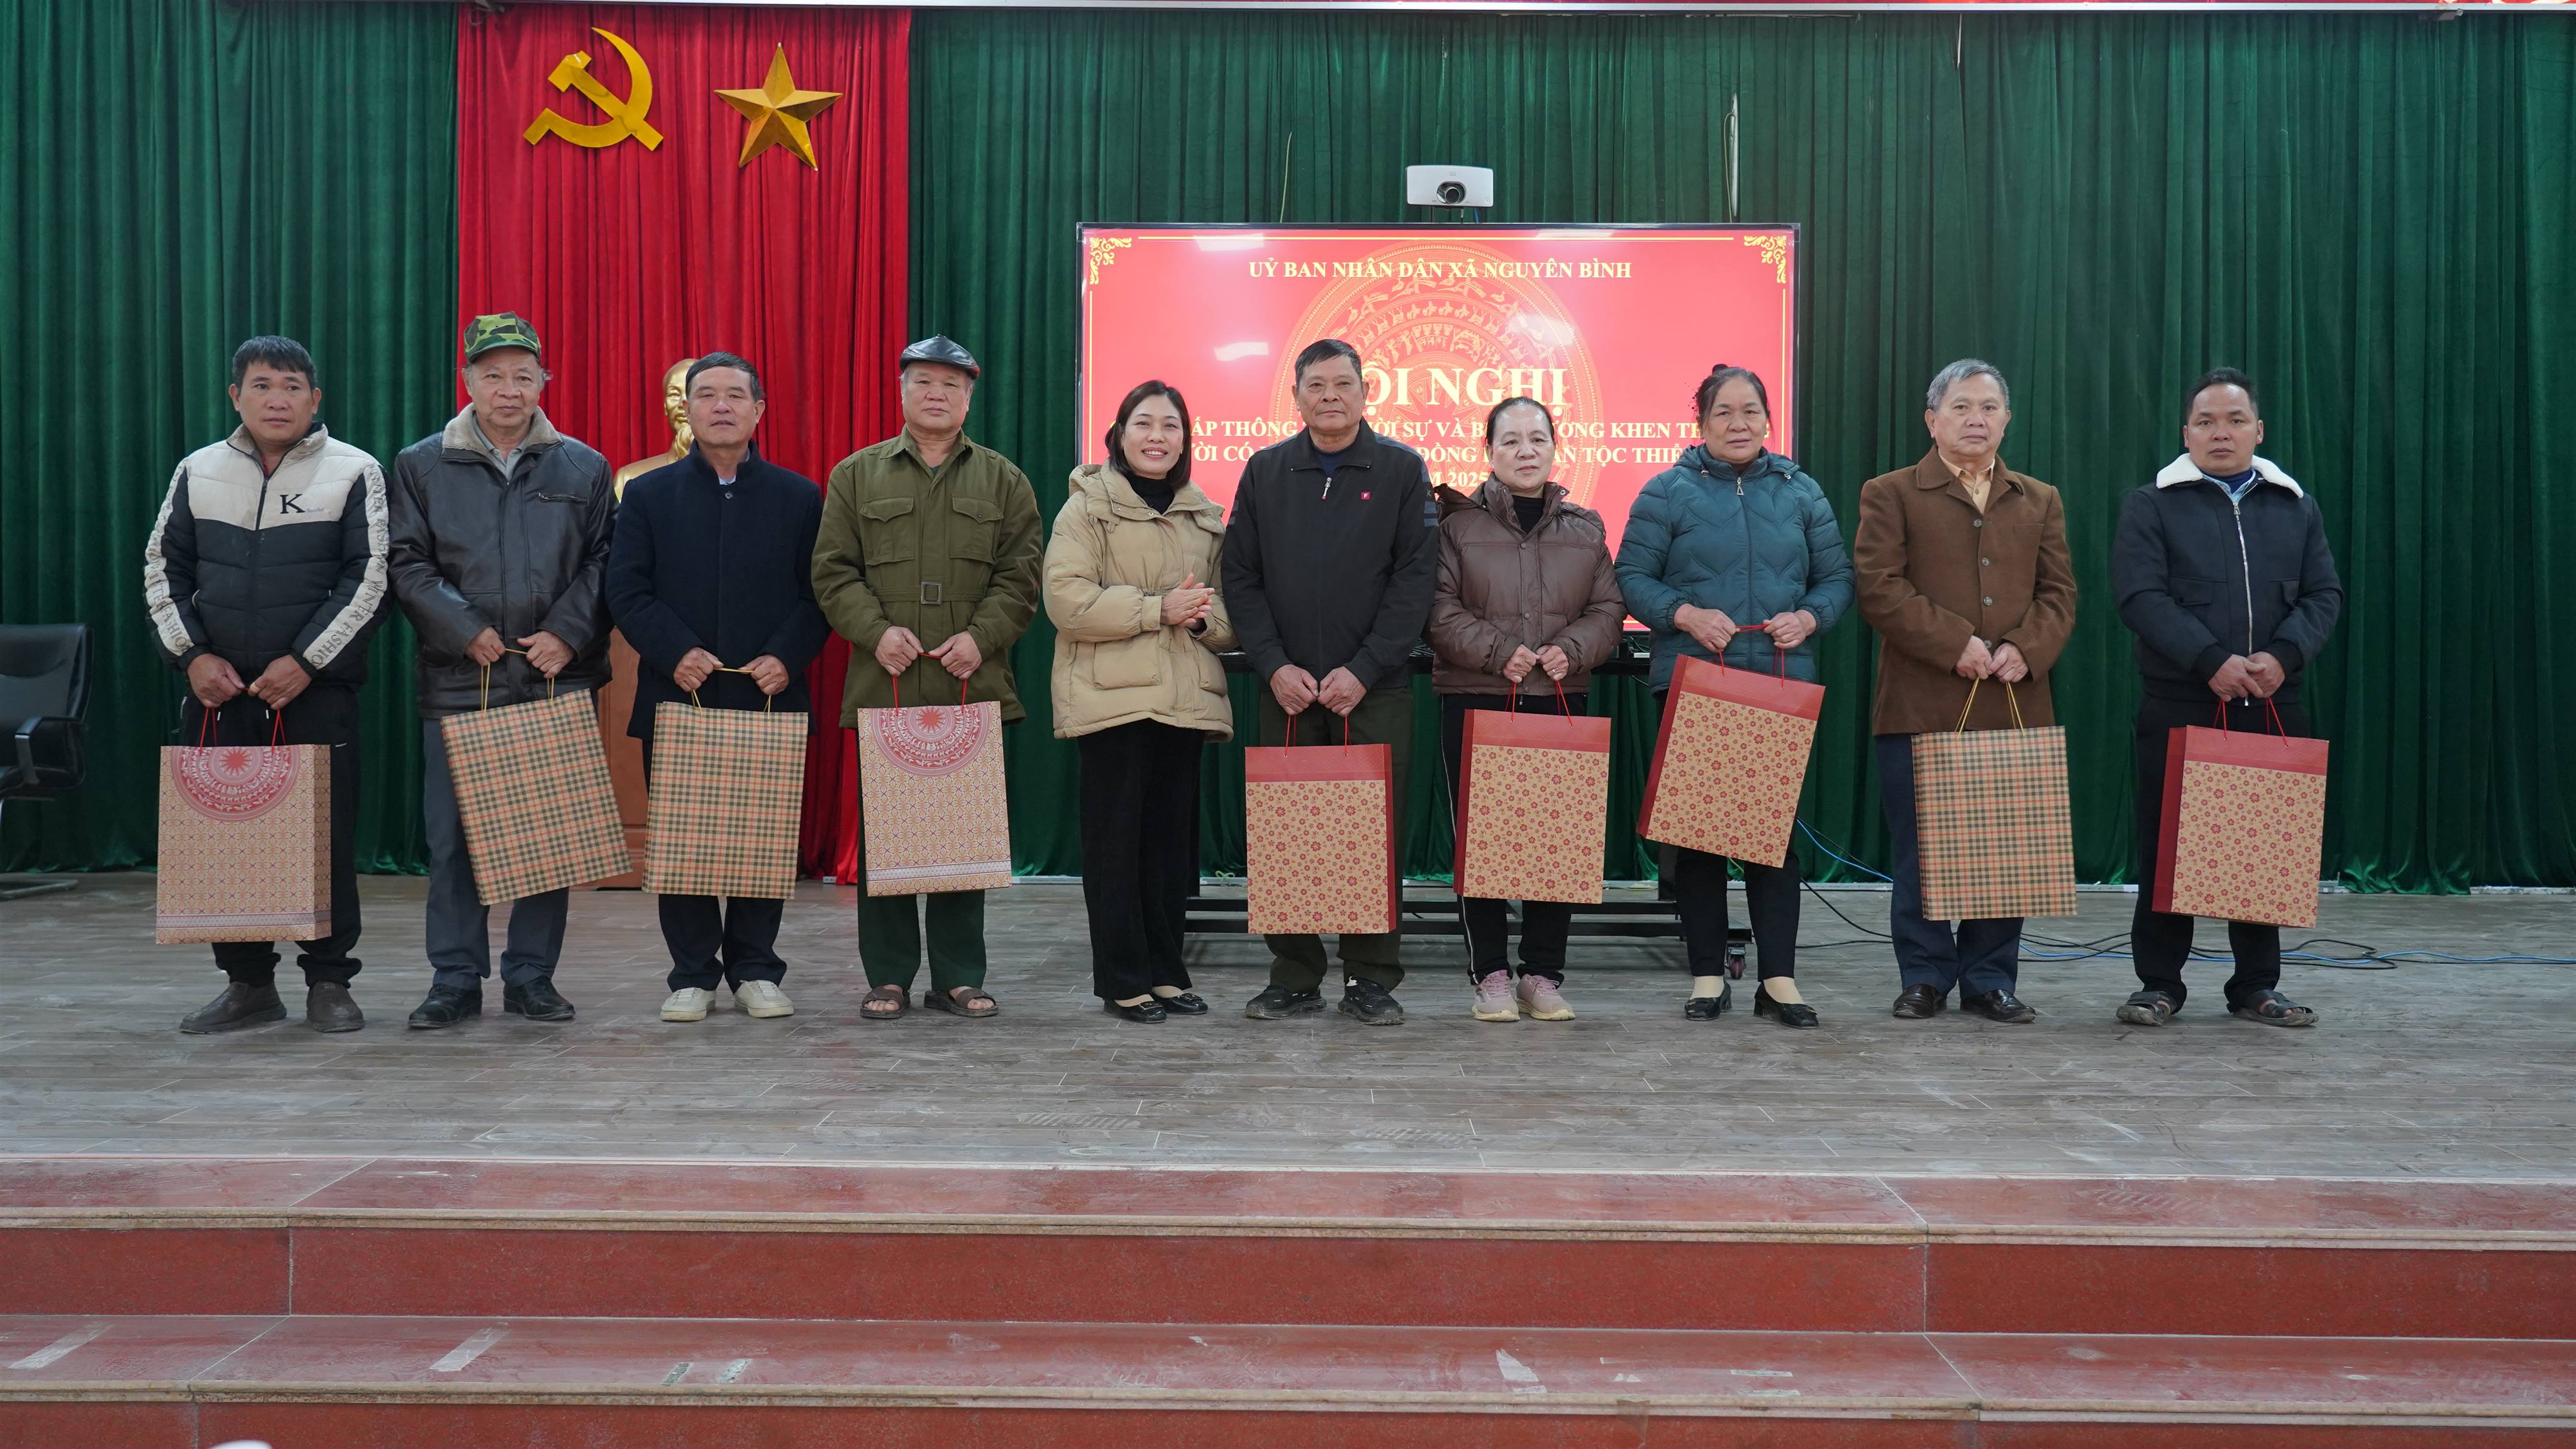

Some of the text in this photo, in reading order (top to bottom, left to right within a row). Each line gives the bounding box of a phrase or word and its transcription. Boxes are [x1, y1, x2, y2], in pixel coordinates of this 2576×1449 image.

[1249, 257, 1632, 278] UỶ BAN NHÂN DÂN XÃ NGUYÊN BÌNH
[1362, 361, 1572, 416] ỘI NGHỊ
[1191, 416, 1218, 436] ẤP
[1221, 416, 1298, 437] THÔNG
[1403, 419, 1433, 441] SỰ
[1436, 418, 1470, 437] VÀ
[1610, 422, 1671, 438] KHEN
[1223, 441, 1254, 462] CÓ
[1582, 444, 1626, 467] TỘC
[1632, 443, 1683, 464] THIỂ
[1448, 472, 1489, 487] 2025
[280, 494, 306, 514] K
[311, 621, 354, 665] FASHIO
